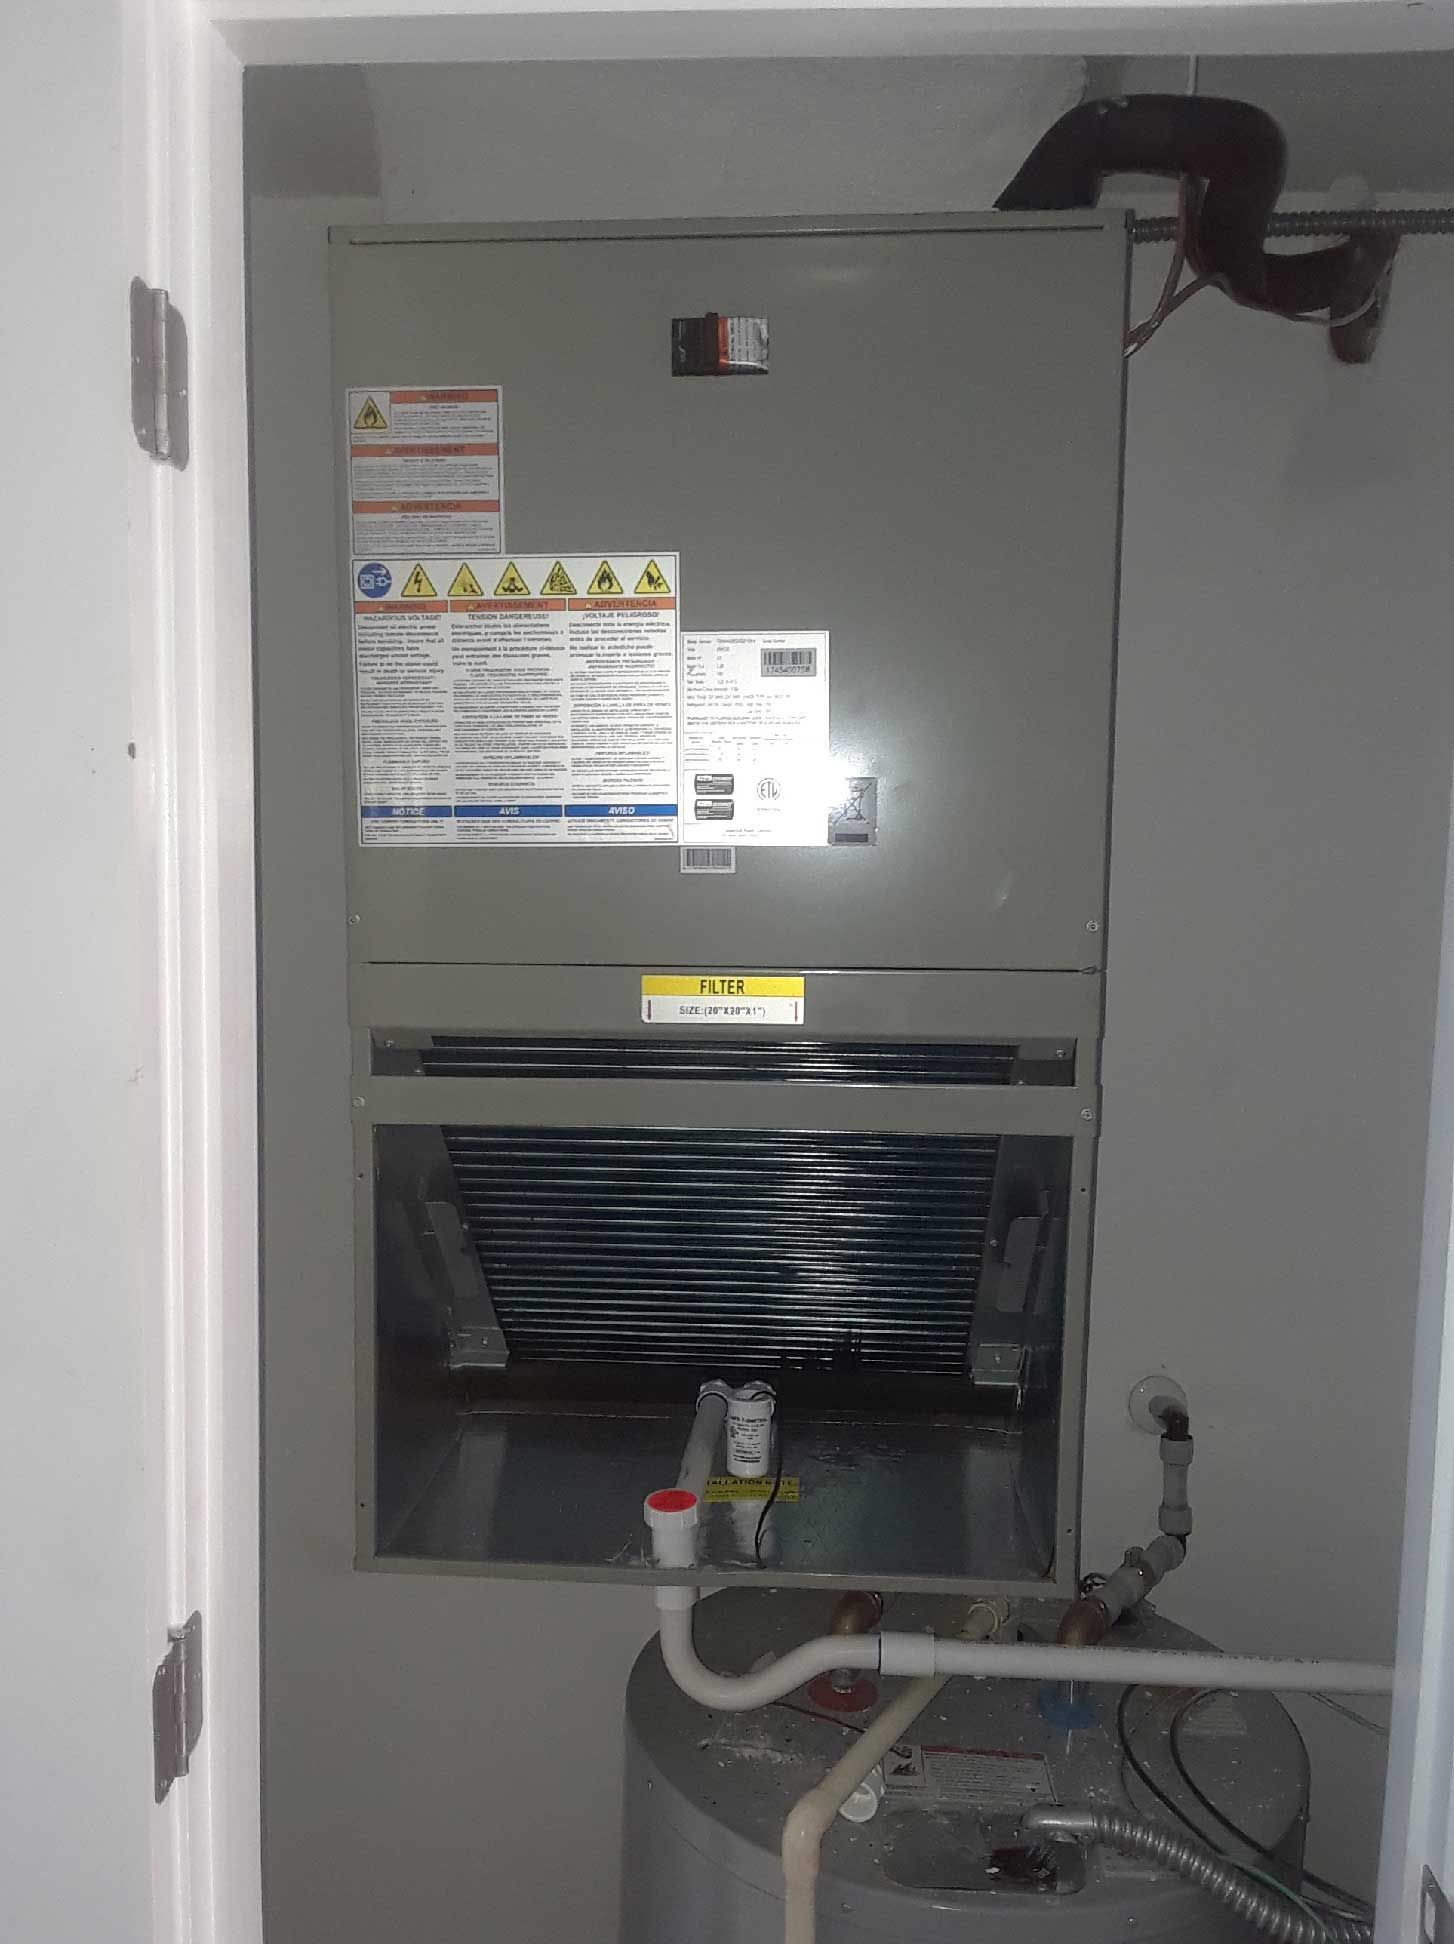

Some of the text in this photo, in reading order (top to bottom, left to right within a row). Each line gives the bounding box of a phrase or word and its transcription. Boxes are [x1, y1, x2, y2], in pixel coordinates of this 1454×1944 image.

[594, 600, 656, 608] ADVERTENCIA
[392, 807, 425, 816] NOTICE
[499, 806, 519, 815] AVIS
[608, 806, 636, 815] AVISO
[700, 979, 745, 994] FILTER
